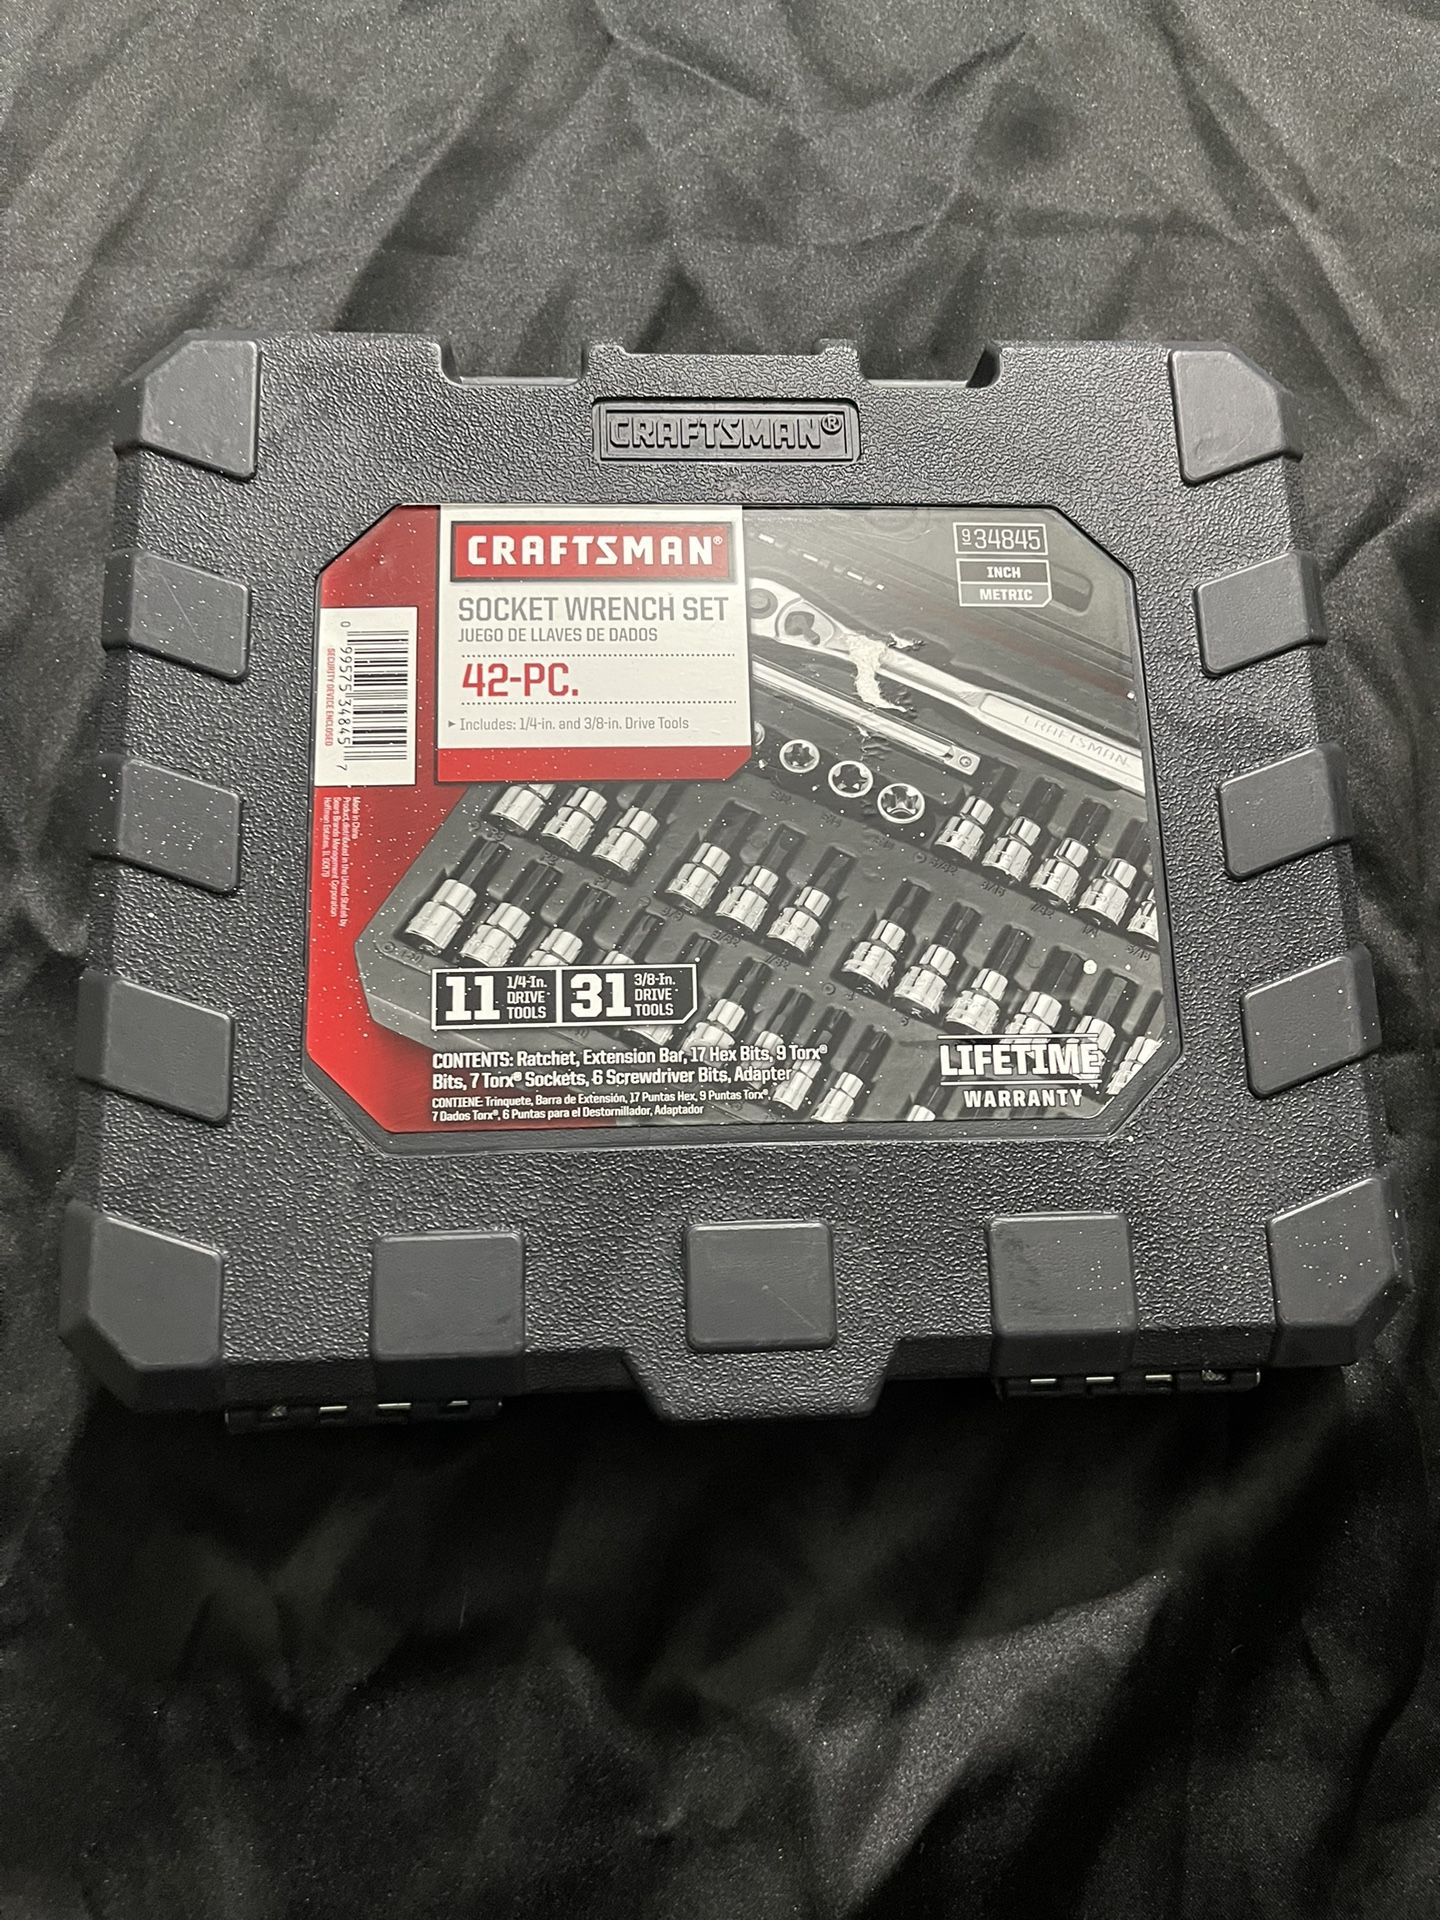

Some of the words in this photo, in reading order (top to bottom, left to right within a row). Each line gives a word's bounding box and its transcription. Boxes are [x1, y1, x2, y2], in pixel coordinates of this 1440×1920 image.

[986, 566, 1021, 578] INCH
[979, 588, 1033, 601] METRIC
[458, 596, 558, 621] SOCKET
[565, 596, 674, 621] WRENCH
[682, 596, 729, 621] SET
[458, 628, 503, 642] JUEGO
[508, 628, 526, 642] DE
[531, 628, 582, 642] LLAVES
[586, 628, 605, 642] DE
[609, 627, 658, 641] DADOS
[326, 648, 336, 683] SECURITY
[461, 662, 578, 697] 42-PC.
[326, 685, 335, 711] DEVICE
[324, 711, 334, 747] ENCLOSED
[459, 717, 516, 731] Includes:
[519, 717, 556, 731] 1/4-in.
[558, 717, 580, 730] and
[584, 717, 622, 730] 3/8-in.
[625, 716, 655, 729] Drive
[659, 716, 689, 729] Tools
[506, 975, 547, 988] 1/4-In.
[634, 972, 676, 986] 3/8-In.
[445, 975, 500, 1021] 11
[506, 990, 546, 1004] DRIVE
[570, 972, 631, 1018] 31
[634, 988, 673, 1001] DRIVE
[506, 1006, 546, 1020] TOOLS
[634, 1003, 674, 1017] TOOLS
[432, 1051, 514, 1069] CONTENTS:
[517, 1050, 580, 1069] Ratchet,
[583, 1048, 656, 1065] Extension
[659, 1047, 688, 1065] Bar,
[690, 1046, 706, 1063] 17
[709, 1046, 737, 1062] Hex
[740, 1046, 774, 1064] Bits,
[776, 1045, 786, 1061] 9
[939, 1043, 1101, 1076] LIFETIME
[432, 1074, 467, 1092] Bits,
[469, 1073, 480, 1088] 7
[525, 1069, 590, 1088] Sockets,
[592, 1069, 603, 1086] 6
[606, 1066, 695, 1086] Screwdriver
[698, 1067, 732, 1085] Bits,
[734, 1067, 793, 1086] Adapter
[485, 1094, 534, 1109] Trinquete,
[535, 1093, 563, 1106] Barra
[564, 1093, 577, 1105] de
[578, 1092, 628, 1106] Extensión,
[629, 1091, 641, 1103] 17
[641, 1090, 676, 1103] Puntas
[699, 1090, 707, 1101] 9
[708, 1089, 742, 1101] Puntas
[963, 1088, 1083, 1108] WARRANTY
[431, 1110, 438, 1121] 7
[439, 1109, 471, 1121] Dados
[502, 1108, 509, 1120] 6
[510, 1107, 546, 1119] Puntas
[547, 1107, 569, 1120] para
[570, 1106, 581, 1117] el
[582, 1104, 653, 1118] Destornillador,
[654, 1103, 704, 1117] Adaptador
